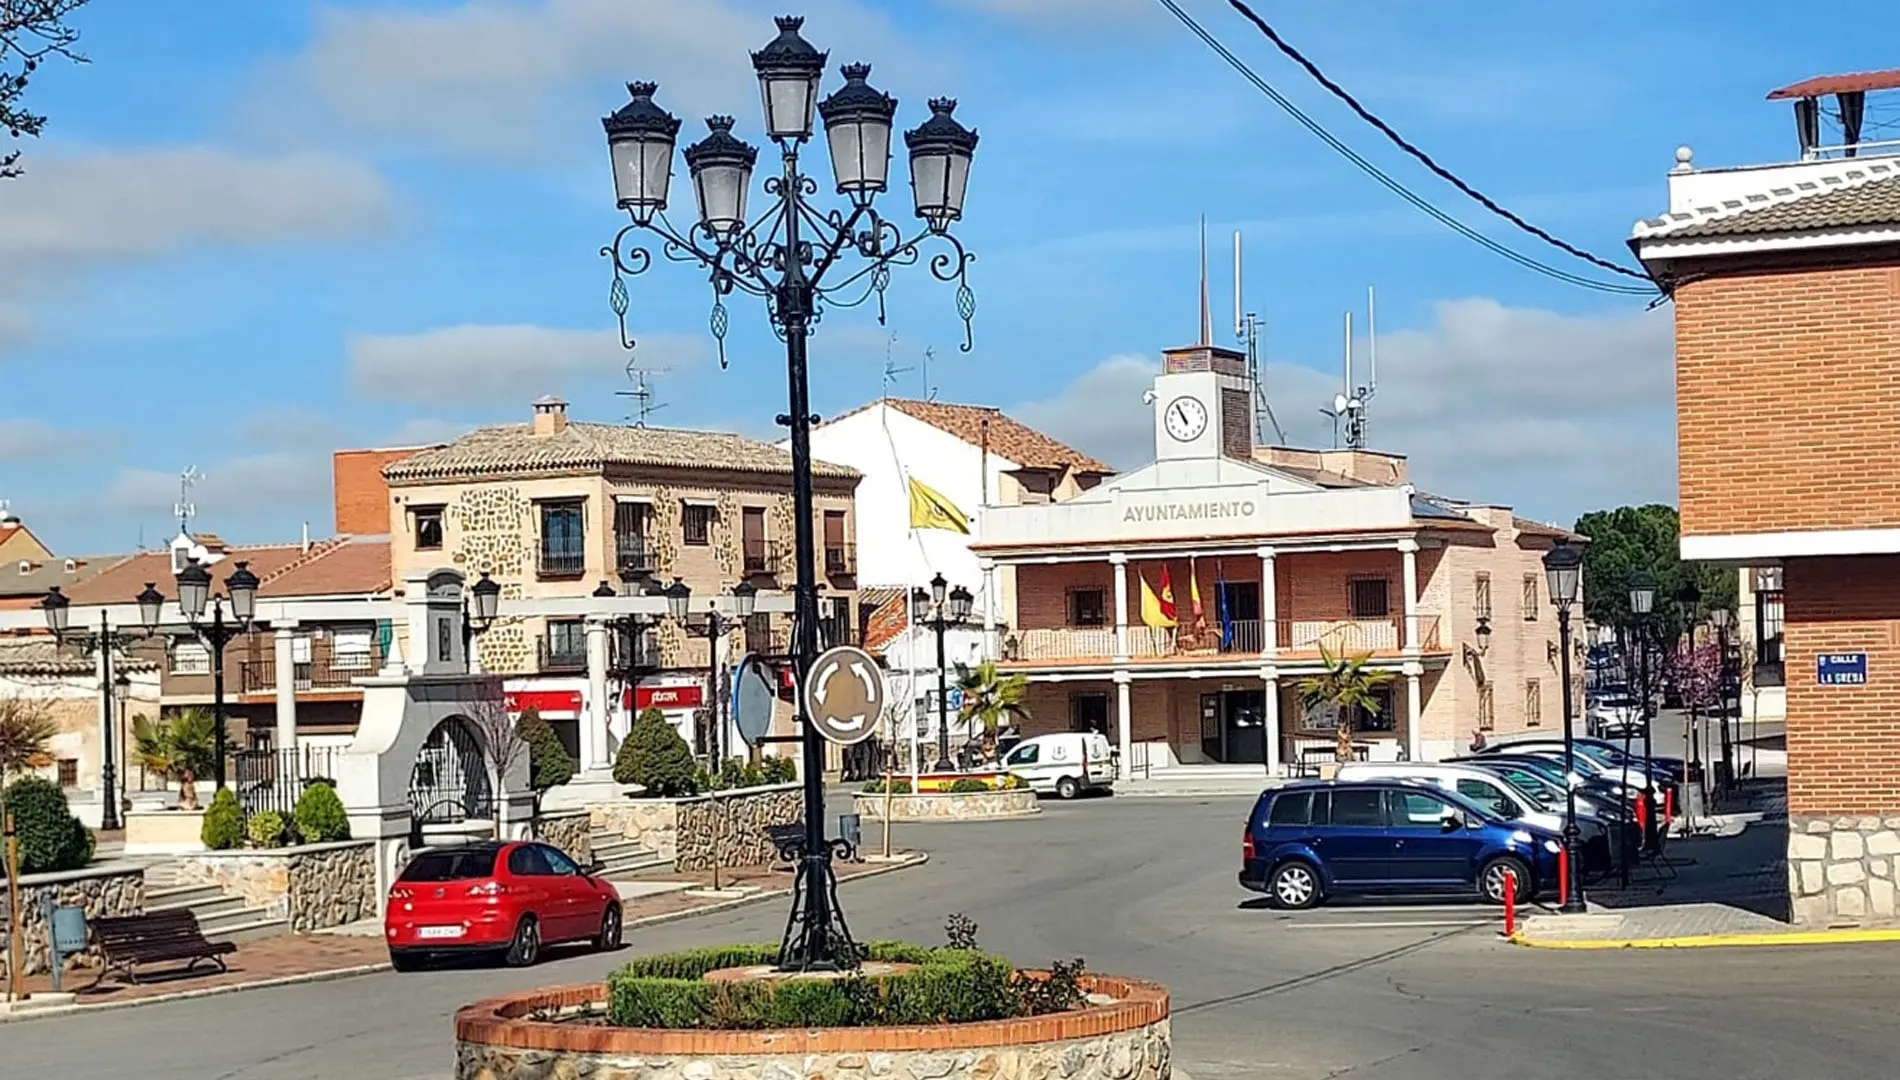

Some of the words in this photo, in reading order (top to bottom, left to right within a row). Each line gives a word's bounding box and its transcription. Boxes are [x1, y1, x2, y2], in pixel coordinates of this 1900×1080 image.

[1123, 501, 1255, 522] AYUNTAMIENTO
[1830, 655, 1859, 664] CALLE
[1820, 673, 1833, 684] LA
